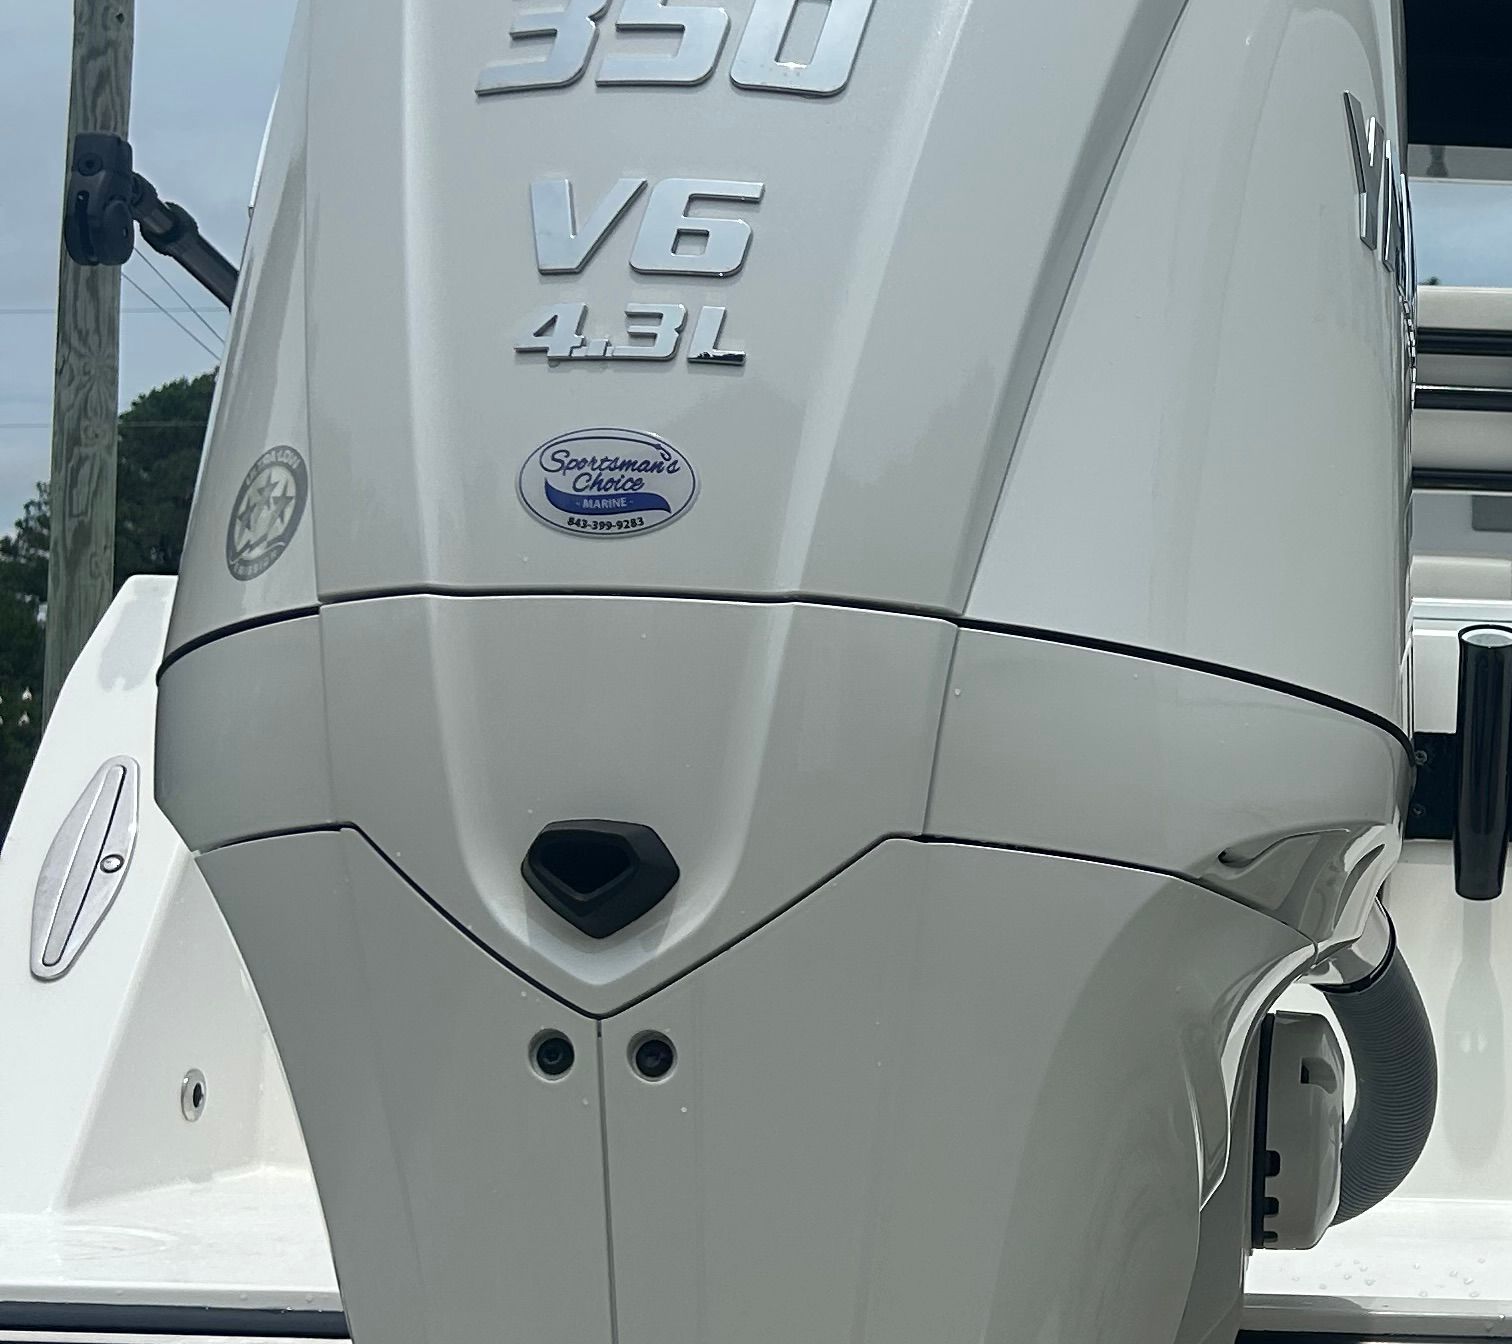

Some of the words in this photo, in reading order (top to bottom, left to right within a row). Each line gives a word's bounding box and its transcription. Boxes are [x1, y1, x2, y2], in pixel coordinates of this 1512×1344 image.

[530, 177, 766, 277] V6
[514, 303, 747, 366] 4.3L
[540, 445, 680, 476] Sportsman's
[572, 472, 645, 493] Choice
[582, 497, 628, 508] MARINE
[567, 517, 645, 530] 843-399-9283
